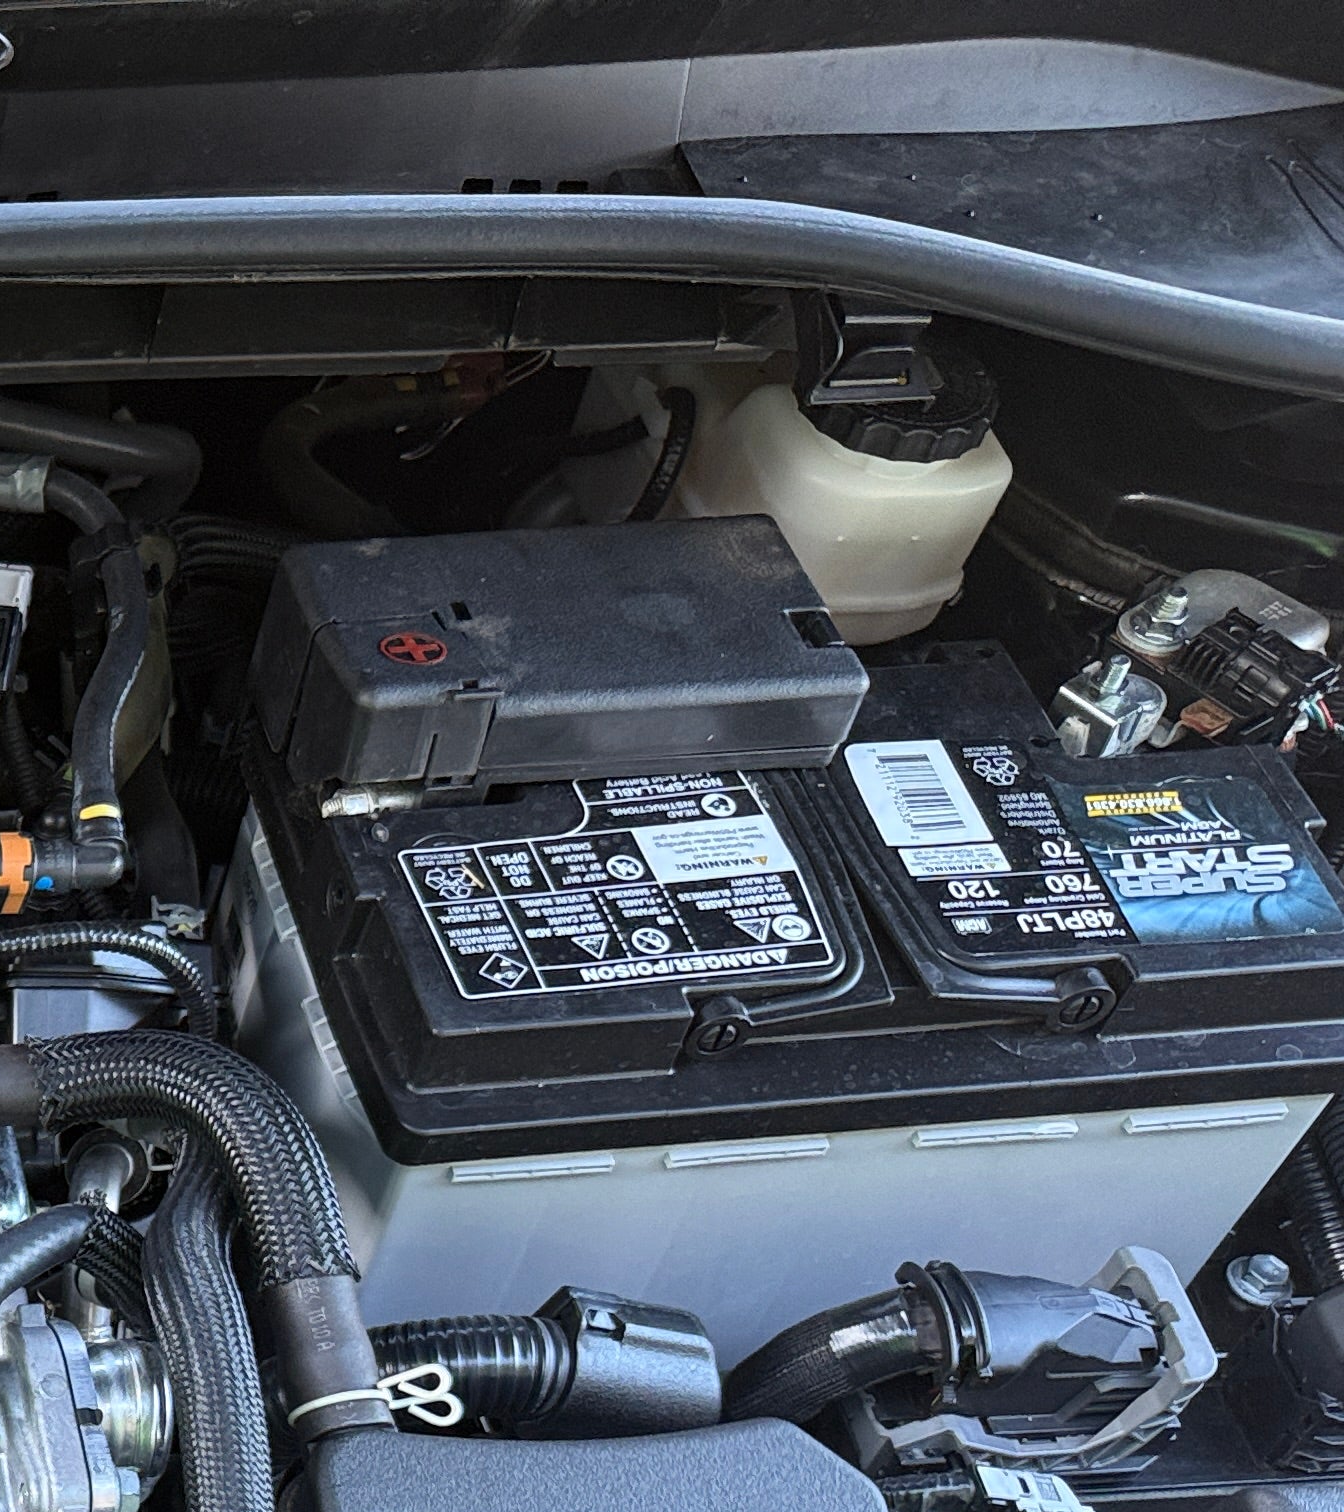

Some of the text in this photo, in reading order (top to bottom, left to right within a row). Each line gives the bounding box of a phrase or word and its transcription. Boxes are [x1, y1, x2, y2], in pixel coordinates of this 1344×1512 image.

[602, 777, 723, 799] NON-SPILLABLE
[666, 808, 700, 818] READ
[1180, 820, 1222, 831] AGM
[1130, 828, 1241, 846] PLATINUM
[1041, 838, 1080, 858] 70
[1109, 844, 1294, 877] START
[501, 864, 530, 876] NOT
[509, 876, 532, 887] DO
[947, 880, 1000, 899] 120
[1044, 873, 1100, 893] 760
[1116, 868, 1287, 898] SUPER
[695, 891, 791, 910] EXPLOSIVE GASES
[759, 904, 798, 915] SHIELD
[954, 919, 988, 931] AGM
[1016, 908, 1115, 934] 48PLTJ
[524, 927, 552, 938] ACID
[485, 942, 517, 952] FLUSH
[580, 949, 770, 983] DANGER/POISON
